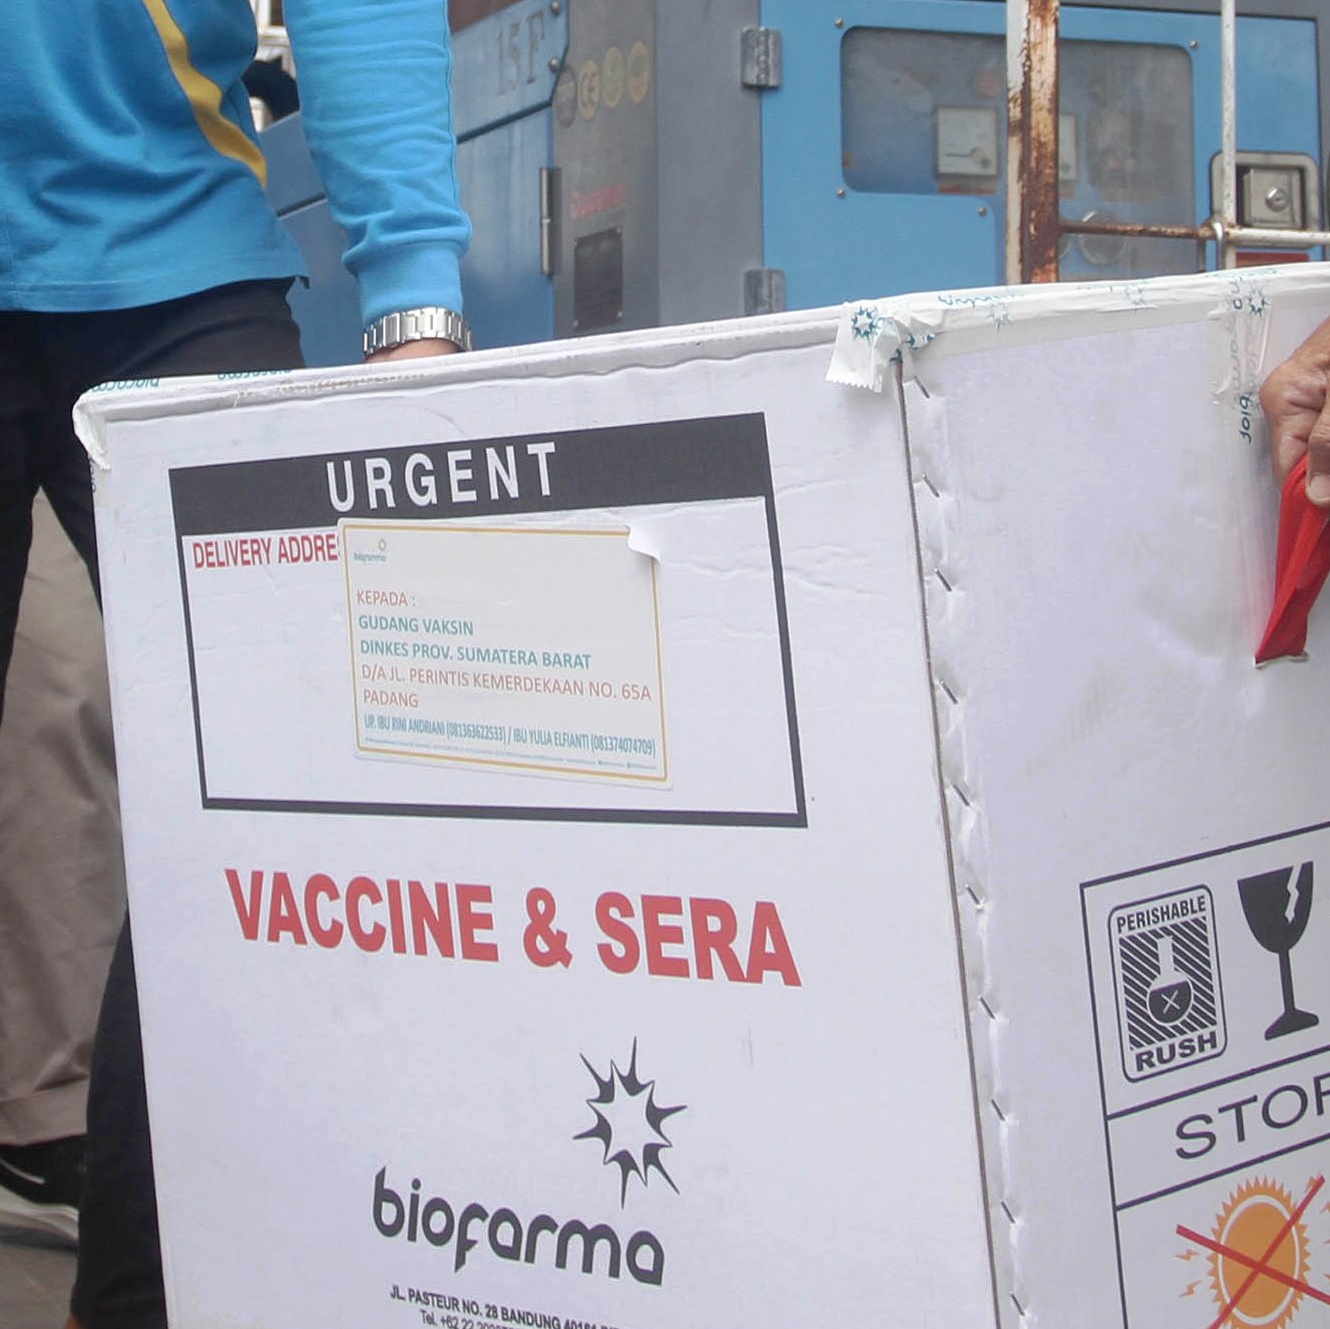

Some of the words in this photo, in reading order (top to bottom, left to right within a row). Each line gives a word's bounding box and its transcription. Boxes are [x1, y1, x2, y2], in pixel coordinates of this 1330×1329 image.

[326, 441, 556, 513] URGENT
[192, 538, 272, 569] DELIVERY
[277, 533, 339, 564] ADDRE
[357, 589, 409, 607] KEPADA
[358, 614, 419, 632] GUDANG
[422, 618, 474, 636] VAKSIN
[360, 640, 409, 657] DINKES
[413, 643, 453, 661] PROV.
[457, 646, 538, 666] SUMATERA
[542, 651, 591, 670] BARAT
[362, 663, 387, 682] D/A
[390, 666, 406, 682] JL.
[409, 667, 469, 687] PERINTIS
[473, 672, 584, 696] KEMERDEKAAN
[589, 681, 617, 699] NO.
[621, 683, 651, 701] 65A
[363, 689, 419, 708] PADANG
[223, 868, 499, 962] VACCINE
[523, 887, 573, 968] &
[595, 890, 803, 987] SERA
[1116, 894, 1207, 934] PERISHABLE
[1135, 1031, 1218, 1072] RUSH
[373, 1166, 664, 1287] biofarma
[408, 1288, 460, 1312] PASTEUR
[462, 1299, 483, 1316] NO.
[484, 1303, 498, 1319] 28
[500, 1306, 560, 1329] BANDUNG
